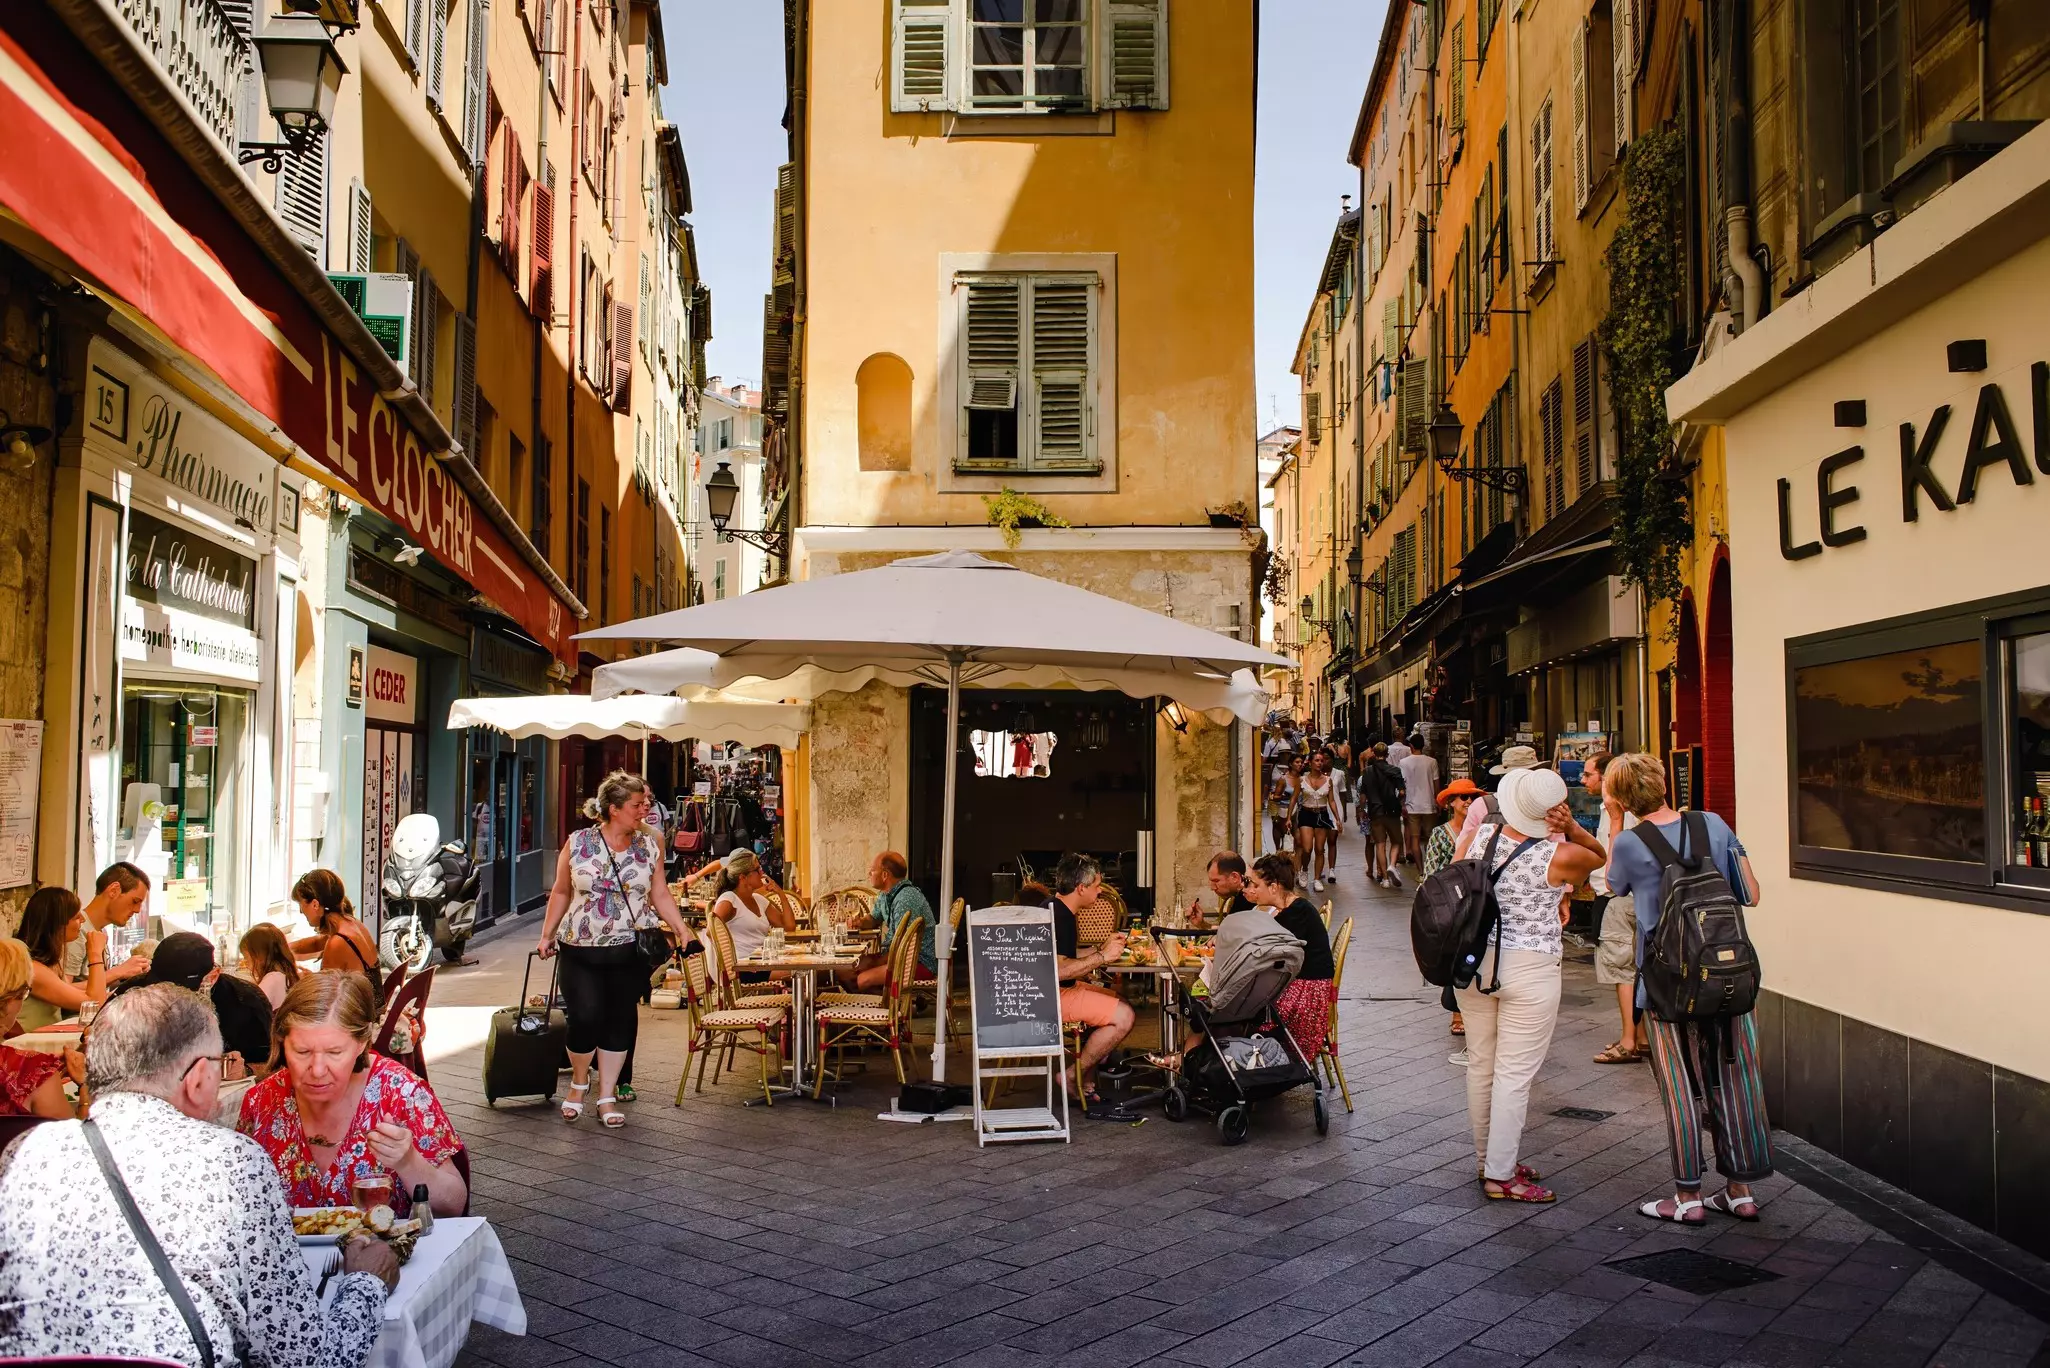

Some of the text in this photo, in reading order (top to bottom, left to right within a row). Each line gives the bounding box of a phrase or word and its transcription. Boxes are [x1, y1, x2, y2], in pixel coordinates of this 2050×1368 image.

[97, 385, 114, 425] 15
[137, 394, 270, 527] Pharmacie
[321, 331, 474, 577] LE CLOCHER
[282, 493, 291, 522] 15
[1777, 445, 1867, 562] LE
[143, 535, 163, 591] la
[169, 541, 251, 617] Cathédrale
[373, 667, 406, 704] CEDER
[385, 754, 391, 781] 37
[384, 791, 391, 815] 41
[369, 759, 377, 917] COMMERCE
[383, 823, 390, 849] 80
